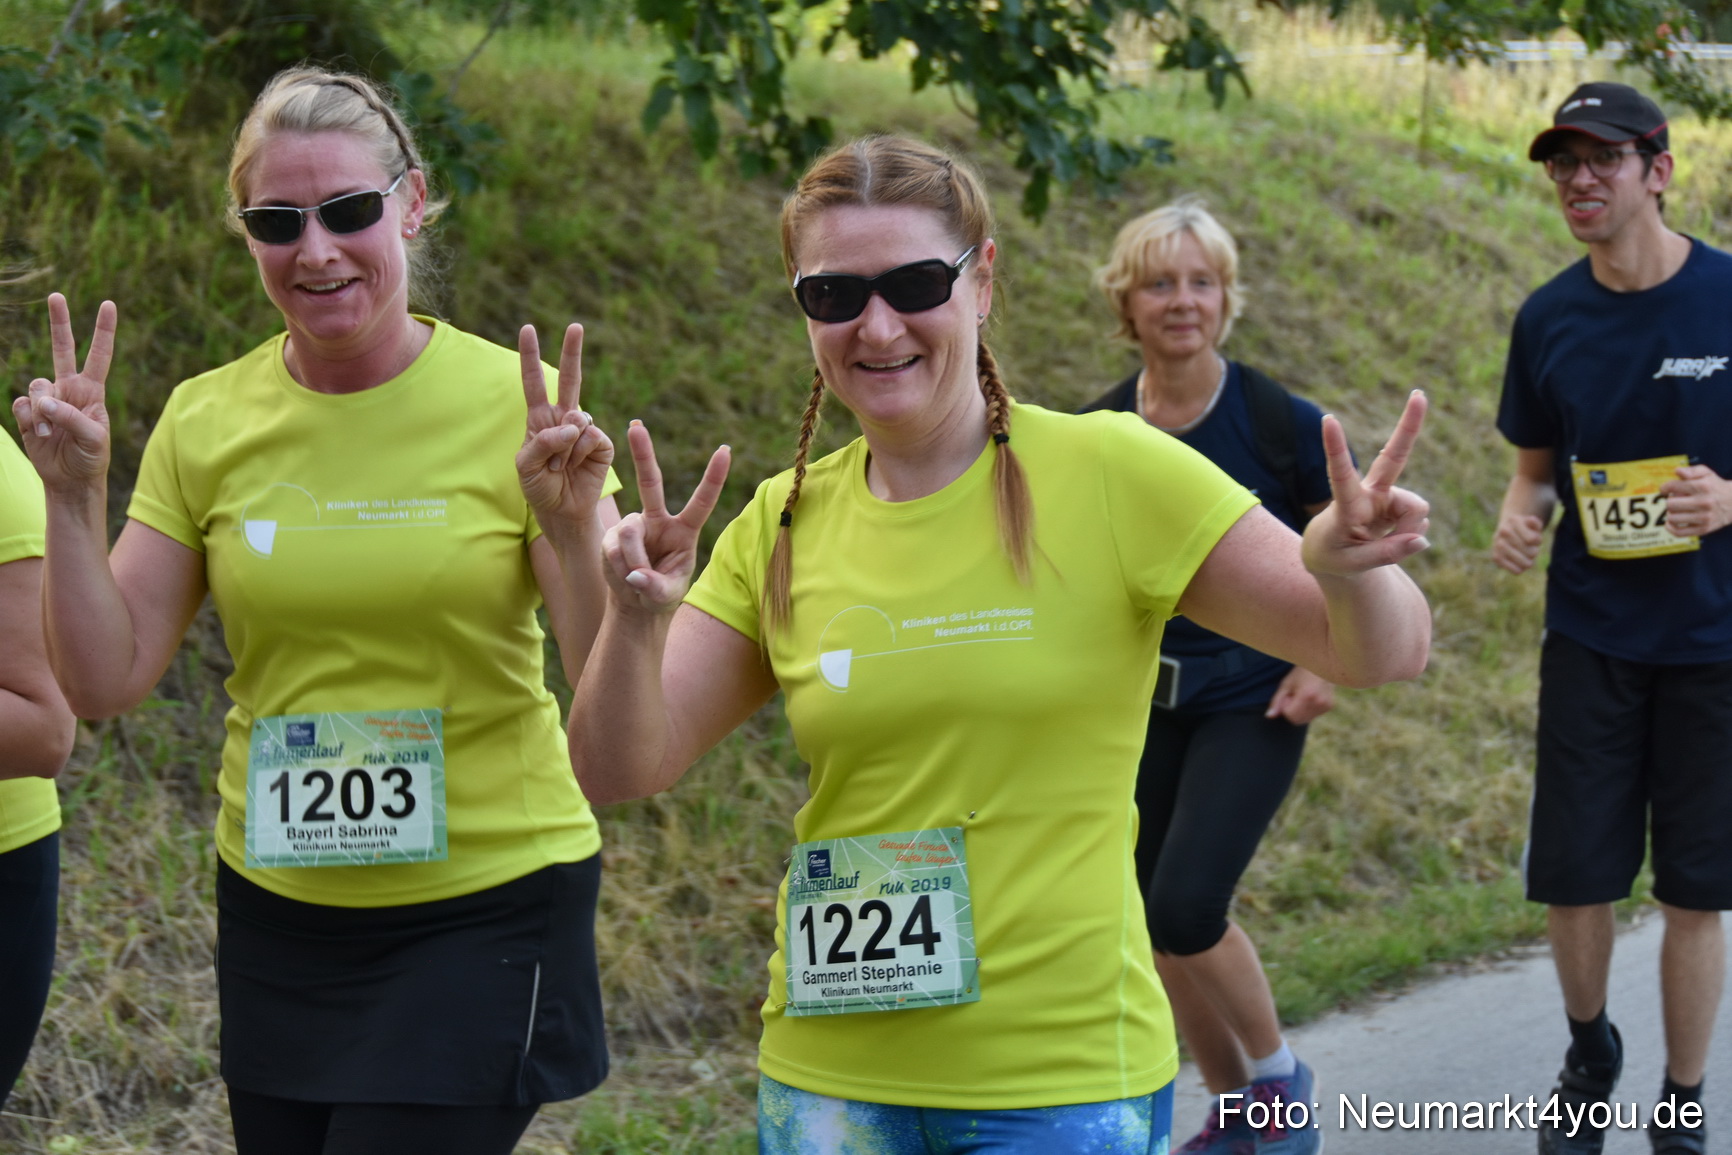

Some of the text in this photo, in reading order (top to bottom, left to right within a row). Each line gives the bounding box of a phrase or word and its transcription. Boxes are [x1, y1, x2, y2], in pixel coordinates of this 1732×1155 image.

[327, 498, 447, 510] Kliniken des Landkreises
[1587, 495, 1669, 530] 1452
[358, 511, 409, 521] Neumarkt
[902, 606, 1033, 629] Kliniken des Landkreises
[934, 624, 991, 638] Neumarkt
[270, 767, 416, 823] 1203
[287, 824, 398, 841] Bayerl Sabrina
[293, 840, 391, 852] Klinikum Neumarkt
[800, 871, 861, 891] firmenlauf
[879, 881, 904, 895] run
[911, 876, 952, 893] 2019
[800, 895, 941, 965] 1224
[803, 962, 942, 985] Gammerl Stephanie
[821, 982, 914, 998] Klinikum Neumarkt
